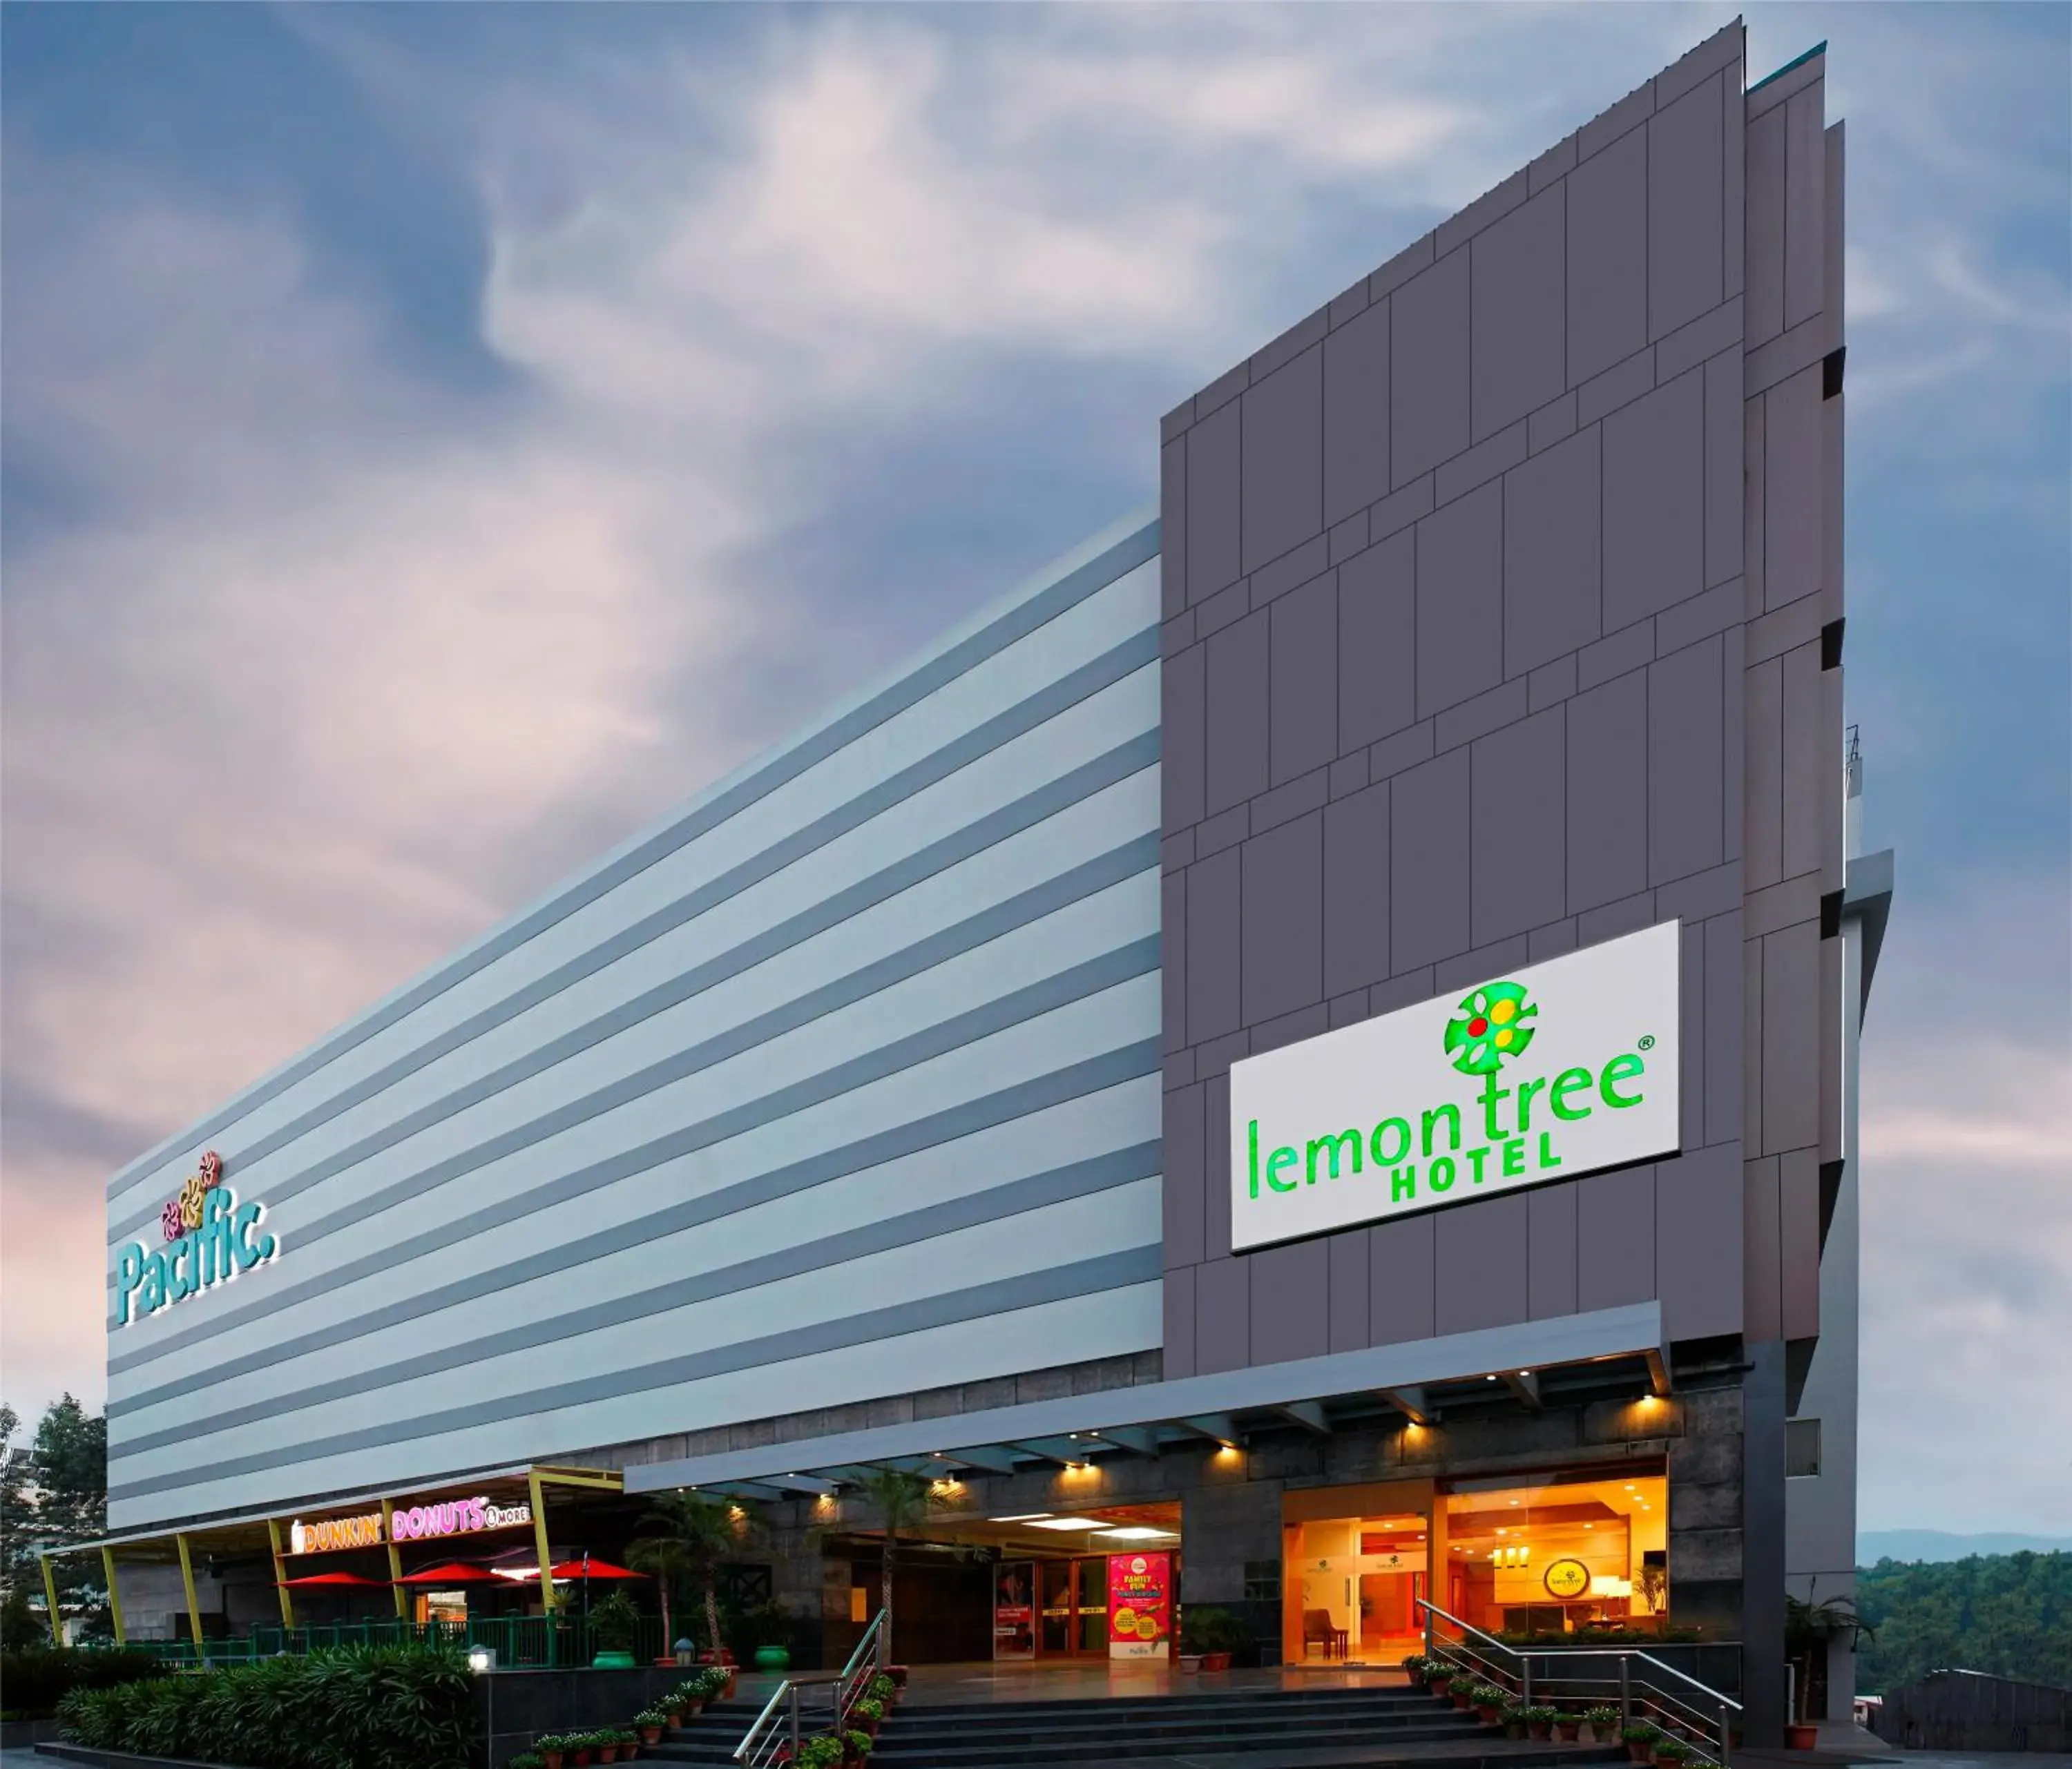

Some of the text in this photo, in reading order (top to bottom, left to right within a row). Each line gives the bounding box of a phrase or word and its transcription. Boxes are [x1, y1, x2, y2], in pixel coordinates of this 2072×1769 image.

[1248, 1103, 1461, 1200] lemon
[1477, 1053, 1645, 1141] tree
[1391, 1132, 1562, 1204] HOTEL
[391, 1496, 485, 1541] DONUTS
[497, 1507, 530, 1525] MORE
